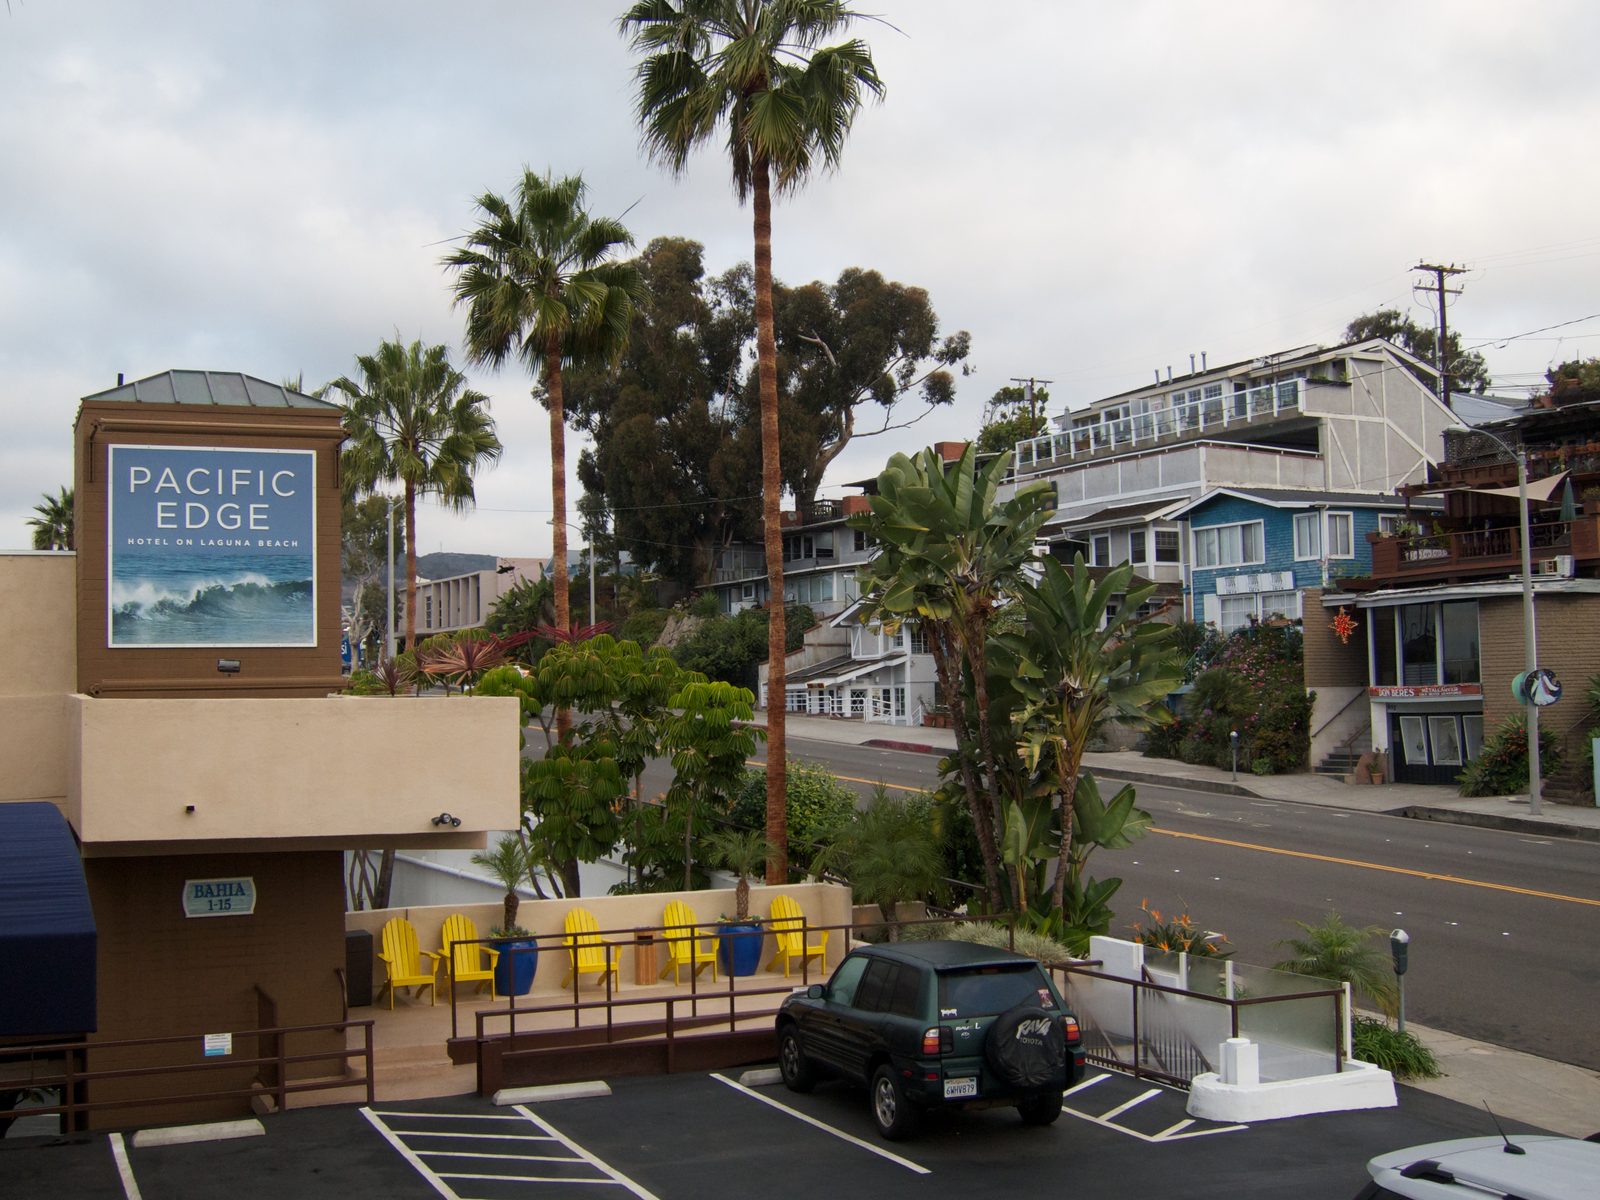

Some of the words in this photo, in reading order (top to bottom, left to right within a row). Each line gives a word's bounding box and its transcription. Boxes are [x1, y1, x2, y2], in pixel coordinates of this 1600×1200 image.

[129, 466, 296, 497] PACIFIC
[156, 502, 270, 530] EDGE
[127, 537, 169, 546] HOTEL
[176, 538, 193, 546] ON
[200, 538, 251, 547] LAGUNA
[258, 539, 299, 547] BEACH
[193, 882, 247, 898] BAHIA
[207, 898, 232, 911] 1-15
[1016, 1017, 1052, 1040] RAV4
[1020, 1037, 1043, 1046] TOYOTA
